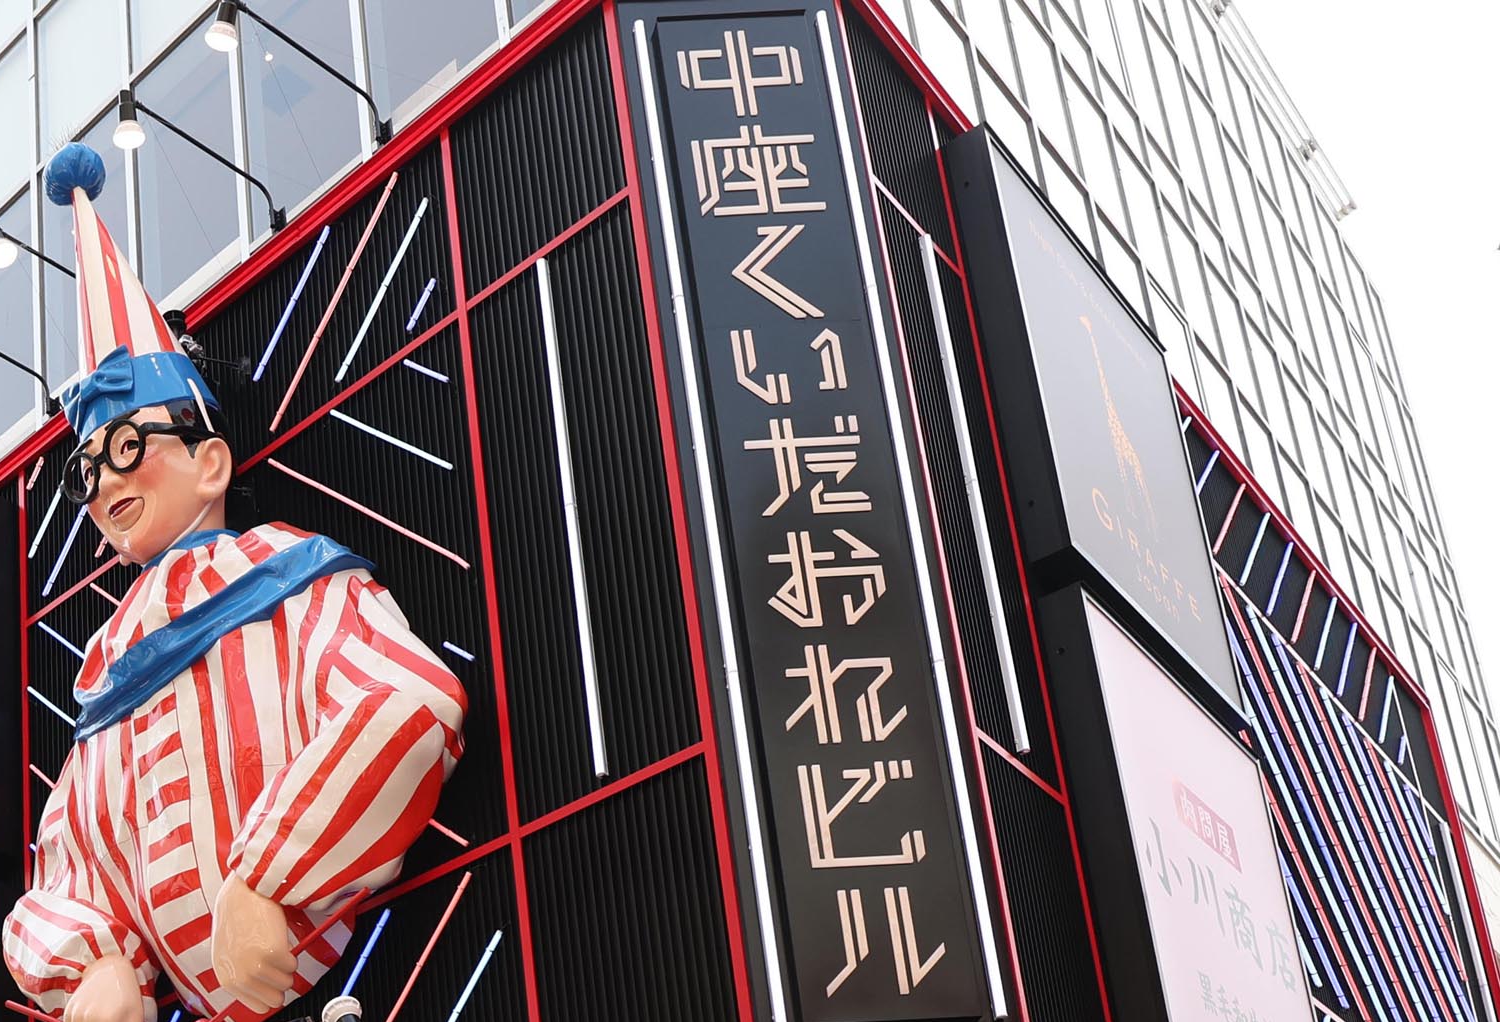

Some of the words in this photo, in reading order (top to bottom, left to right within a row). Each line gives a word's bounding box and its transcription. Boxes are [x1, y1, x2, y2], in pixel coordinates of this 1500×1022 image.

[677, 30, 946, 998] 中座くいだおれビル
[1092, 487, 1203, 623] GIRAFFE
[1145, 817, 1298, 993] 小川商店
